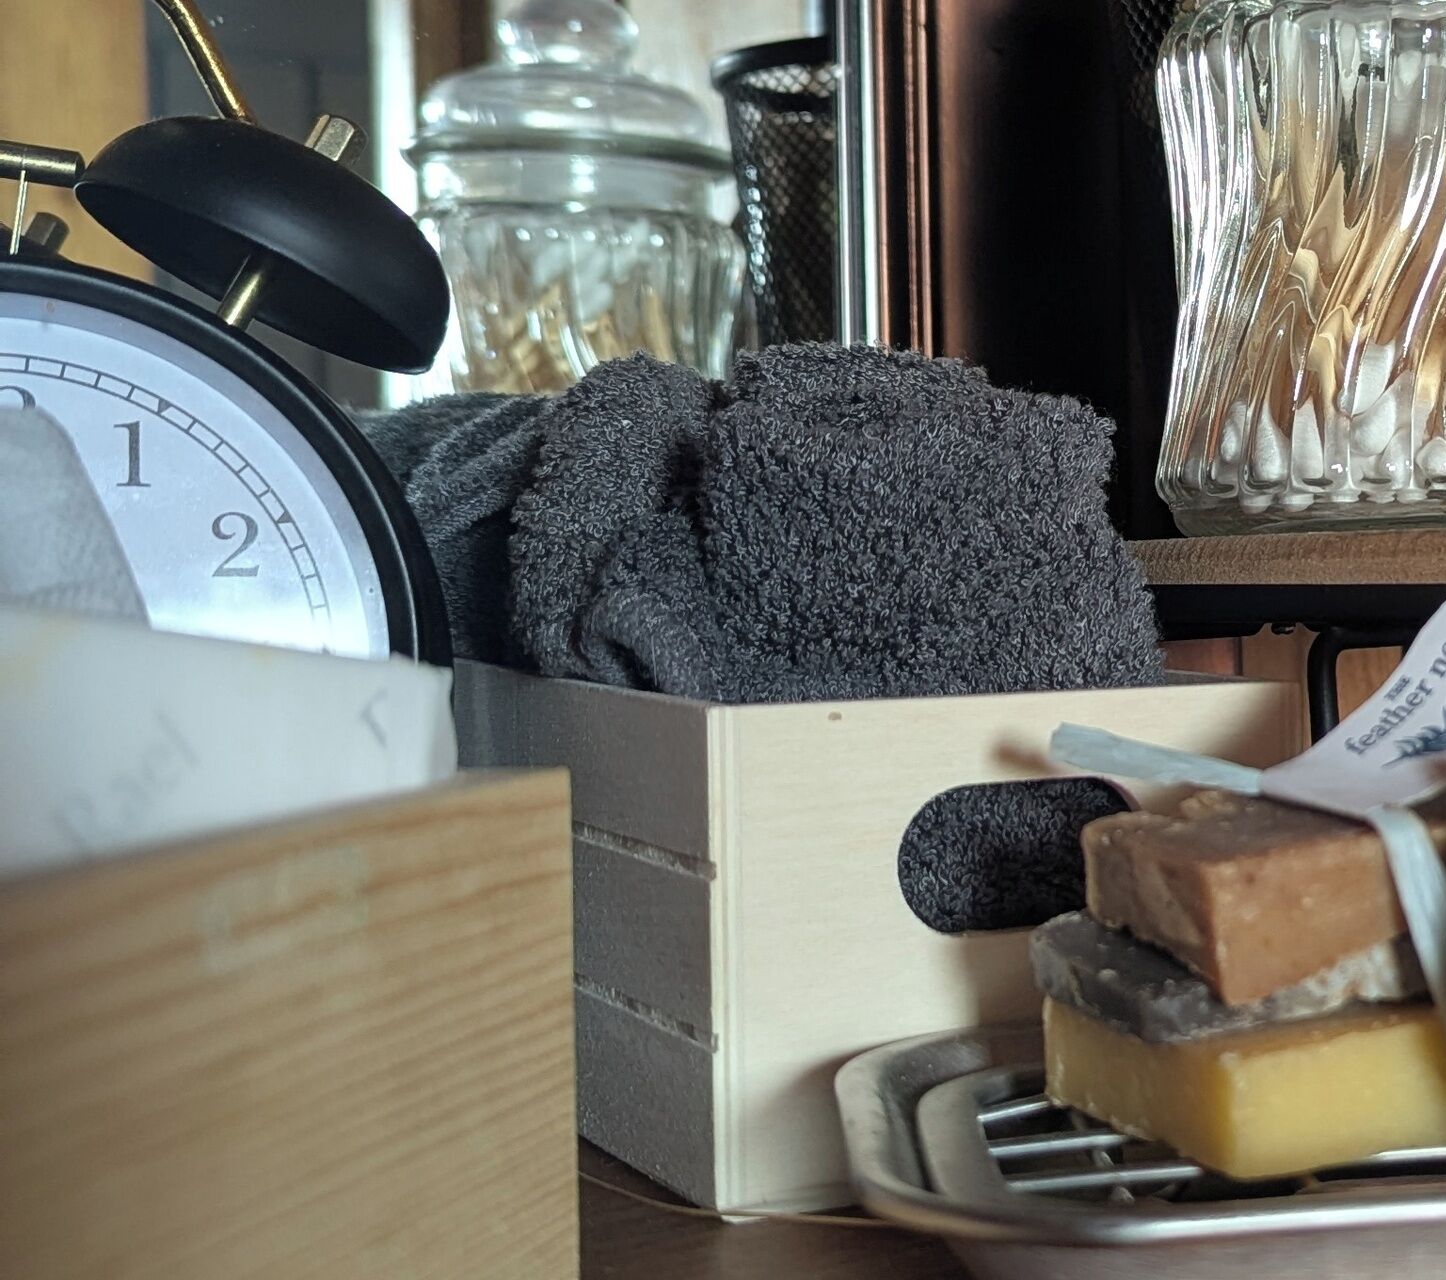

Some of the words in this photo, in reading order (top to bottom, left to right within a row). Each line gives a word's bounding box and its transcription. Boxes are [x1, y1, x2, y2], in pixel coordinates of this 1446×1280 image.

[113, 420, 151, 487] 1
[212, 511, 260, 577] 2
[1344, 677, 1433, 756] feather
